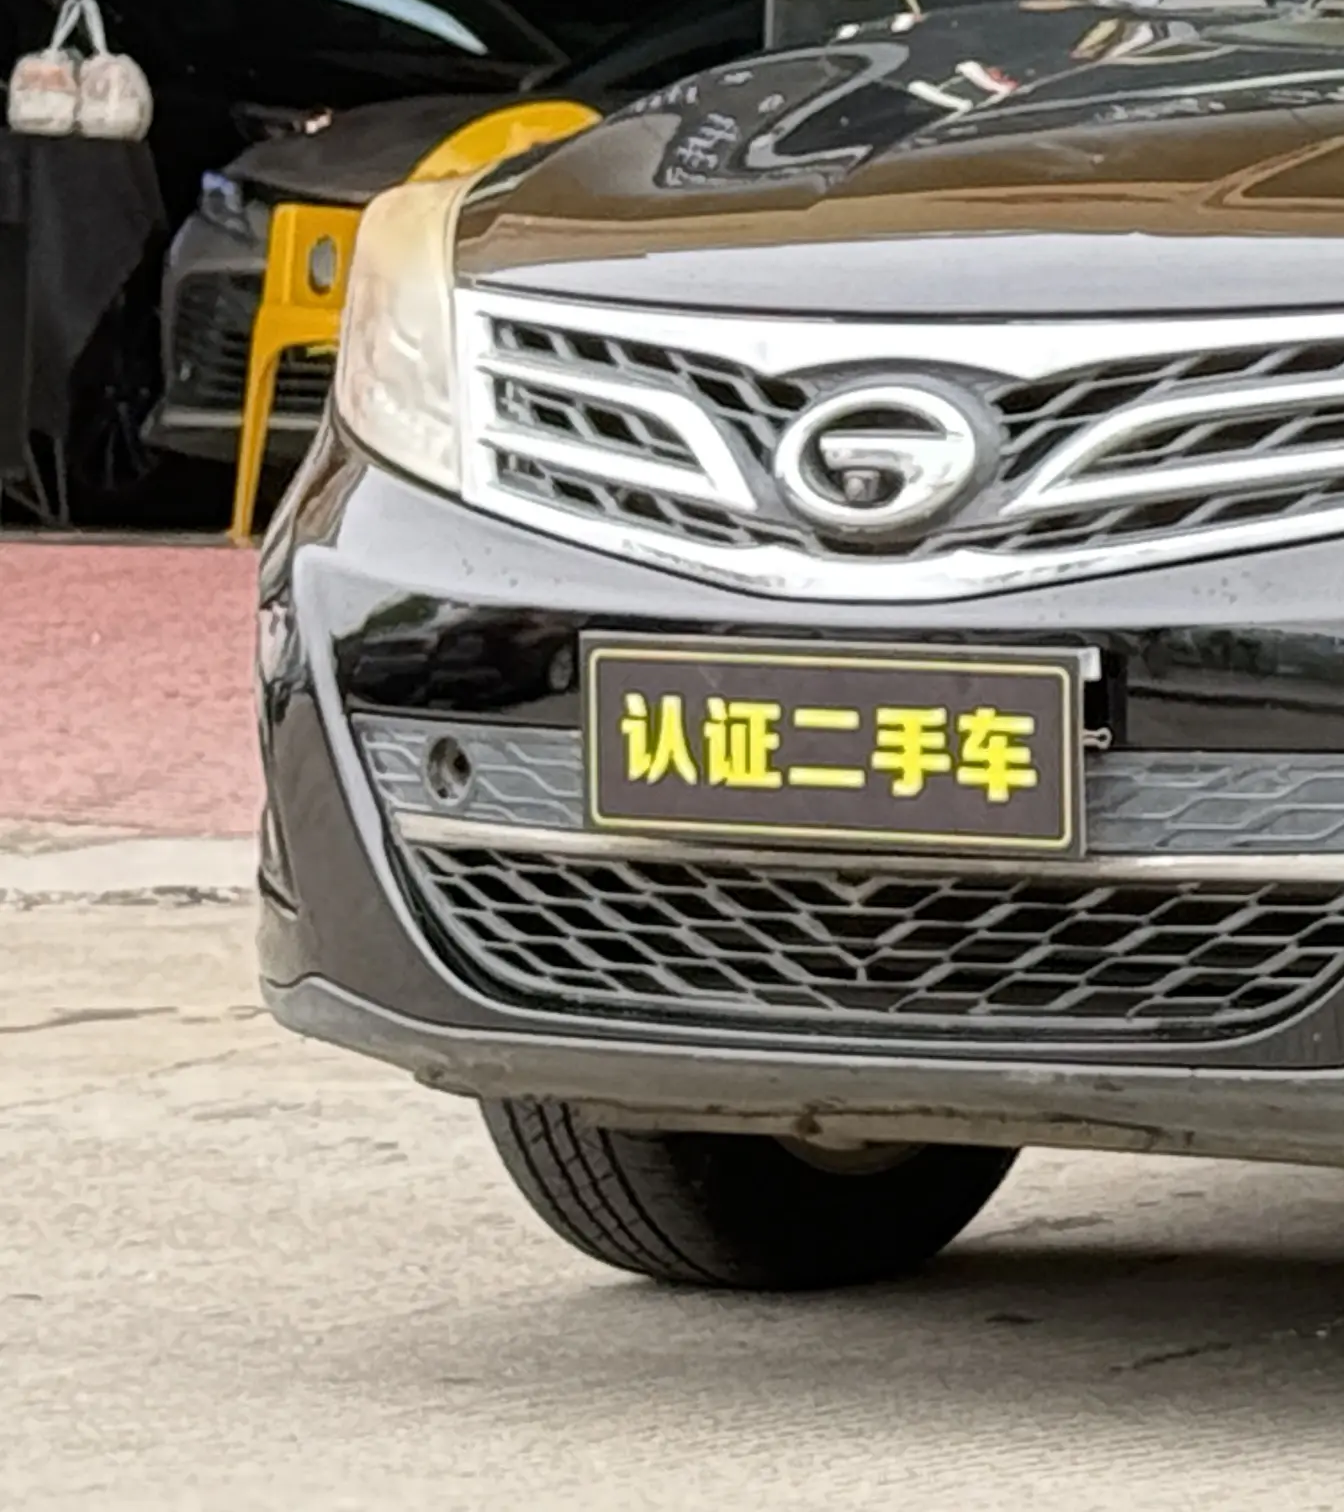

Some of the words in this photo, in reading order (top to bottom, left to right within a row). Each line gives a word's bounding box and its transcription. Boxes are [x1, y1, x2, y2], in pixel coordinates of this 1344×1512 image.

[620, 692, 1038, 803] 认证二手车
